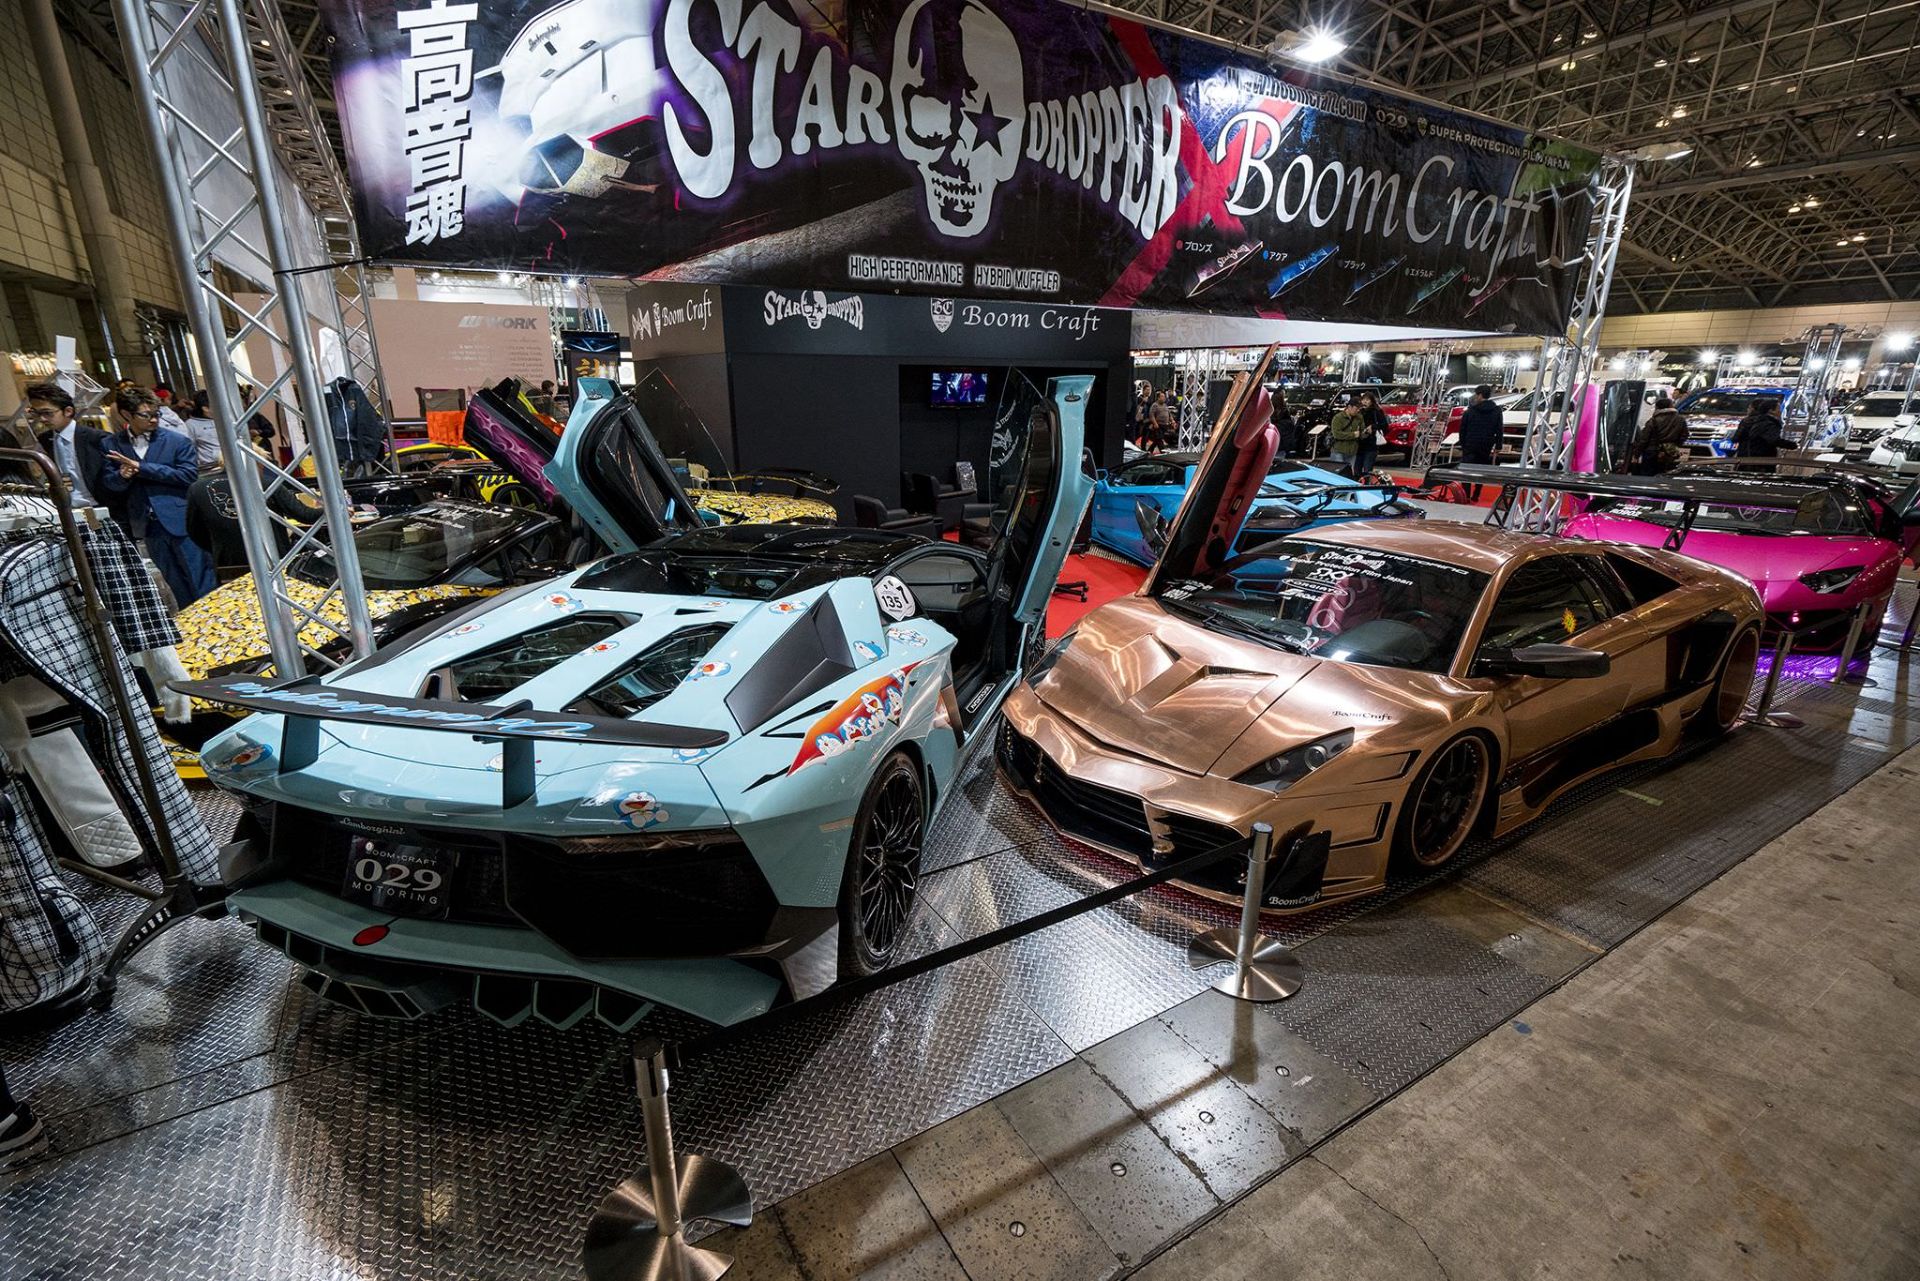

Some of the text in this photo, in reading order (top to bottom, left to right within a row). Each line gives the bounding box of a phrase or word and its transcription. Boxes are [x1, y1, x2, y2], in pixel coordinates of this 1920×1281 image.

[1226, 67, 1368, 123] ww.boomcraft.com
[397, 0, 478, 246] 高音魂
[1026, 74, 1182, 241] DROPPER
[1429, 125, 1463, 143] SUPER
[1464, 135, 1521, 157] PROTECTION
[1522, 149, 1544, 164] FILM
[1184, 240, 1213, 253] ブロンズ
[1268, 251, 1288, 261] アクア
[850, 256, 1060, 291] HIGH PERFORMANCE HYBRID MUFFLER
[662, 307, 684, 327] Boom
[686, 289, 712, 331] Craft
[764, 290, 865, 331] STAR DROPPER
[962, 305, 1031, 328] Boom
[1041, 308, 1101, 341] Craft
[1315, 561, 1361, 573] Protection
[1361, 568, 1382, 579] Film
[1382, 574, 1414, 586] Japan
[352, 881, 438, 905] MOTORING
[355, 858, 443, 892] 029
